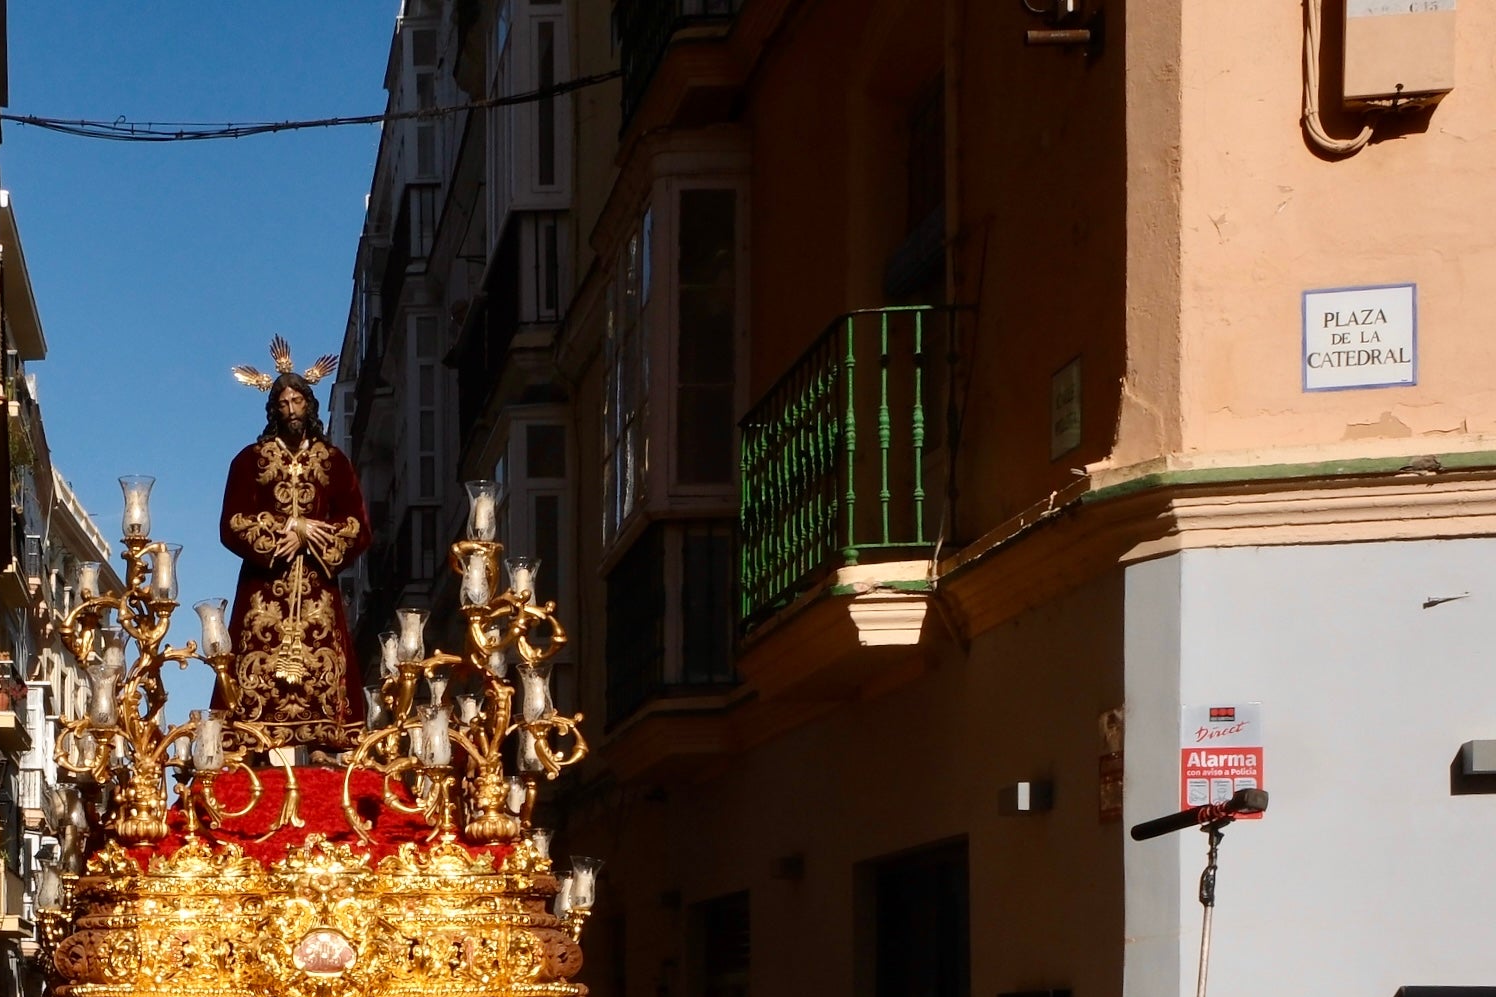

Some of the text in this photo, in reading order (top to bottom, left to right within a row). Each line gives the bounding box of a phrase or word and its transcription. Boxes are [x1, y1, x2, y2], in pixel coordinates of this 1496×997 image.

[1323, 308, 1388, 329] PLAZA
[1331, 331, 1381, 346] DE LA
[1307, 347, 1411, 369] CATEDRAL
[1195, 721, 1250, 743] Direct
[1187, 750, 1257, 768] Alarma
[1186, 769, 1201, 777] con
[1202, 767, 1223, 777] aviso
